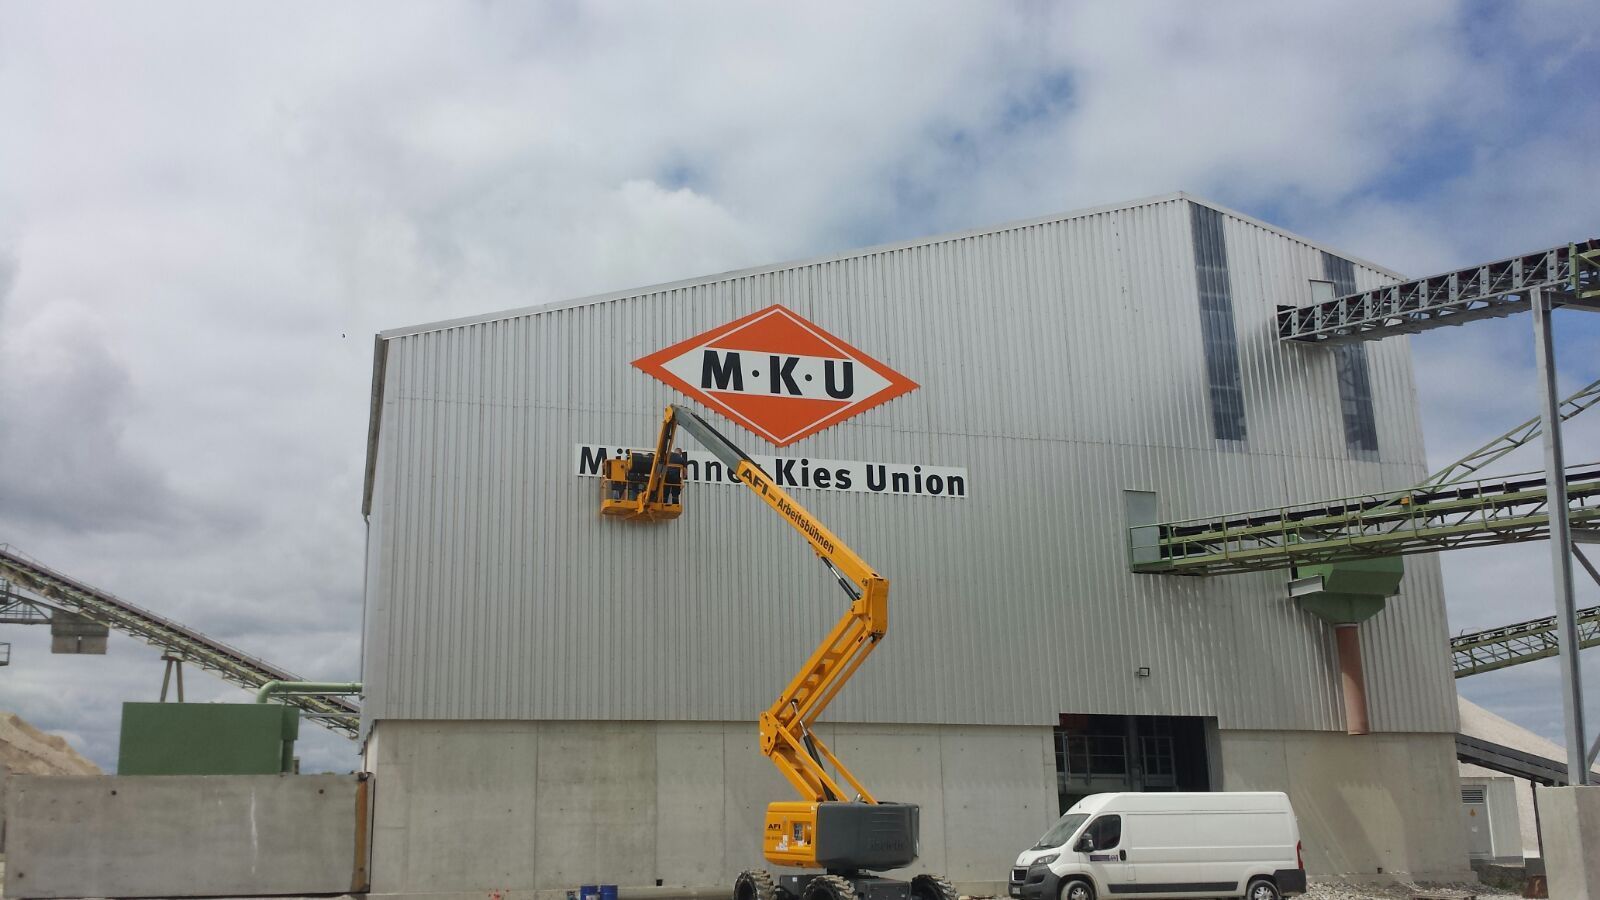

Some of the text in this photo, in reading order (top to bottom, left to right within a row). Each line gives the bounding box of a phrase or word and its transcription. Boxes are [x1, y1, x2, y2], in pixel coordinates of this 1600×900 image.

[775, 458, 852, 490] Kies
[866, 465, 965, 496] Union
[741, 468, 769, 497] AFI
[777, 498, 834, 554] Arbeitsbühnen
